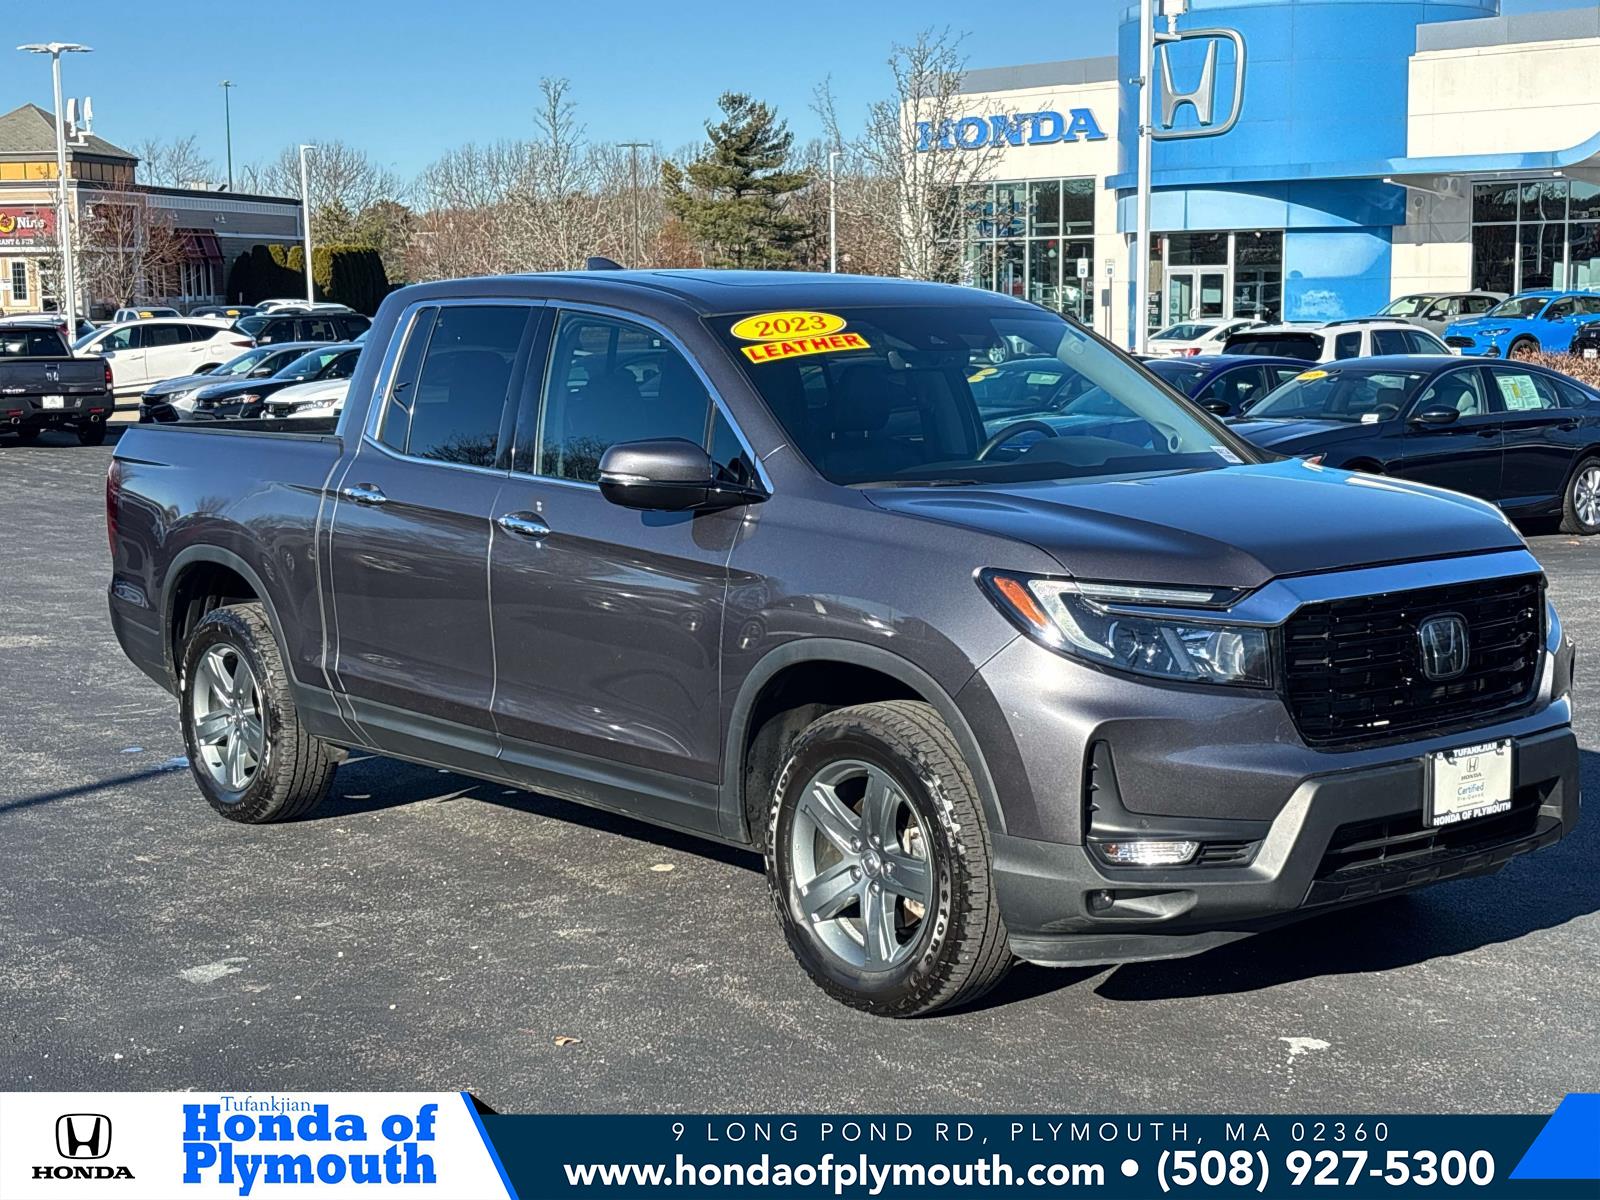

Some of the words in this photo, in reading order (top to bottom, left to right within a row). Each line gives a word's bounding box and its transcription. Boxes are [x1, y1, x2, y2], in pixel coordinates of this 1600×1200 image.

[914, 108, 1108, 152] HONDA
[755, 315, 827, 337] 2023
[749, 335, 865, 361] LEATHER
[1461, 772, 1482, 781] HONDA
[1457, 782, 1485, 796] Certified
[1433, 812, 1460, 826] HONDA
[1461, 809, 1473, 820] OF
[1473, 801, 1512, 818] PLYMOUTH
